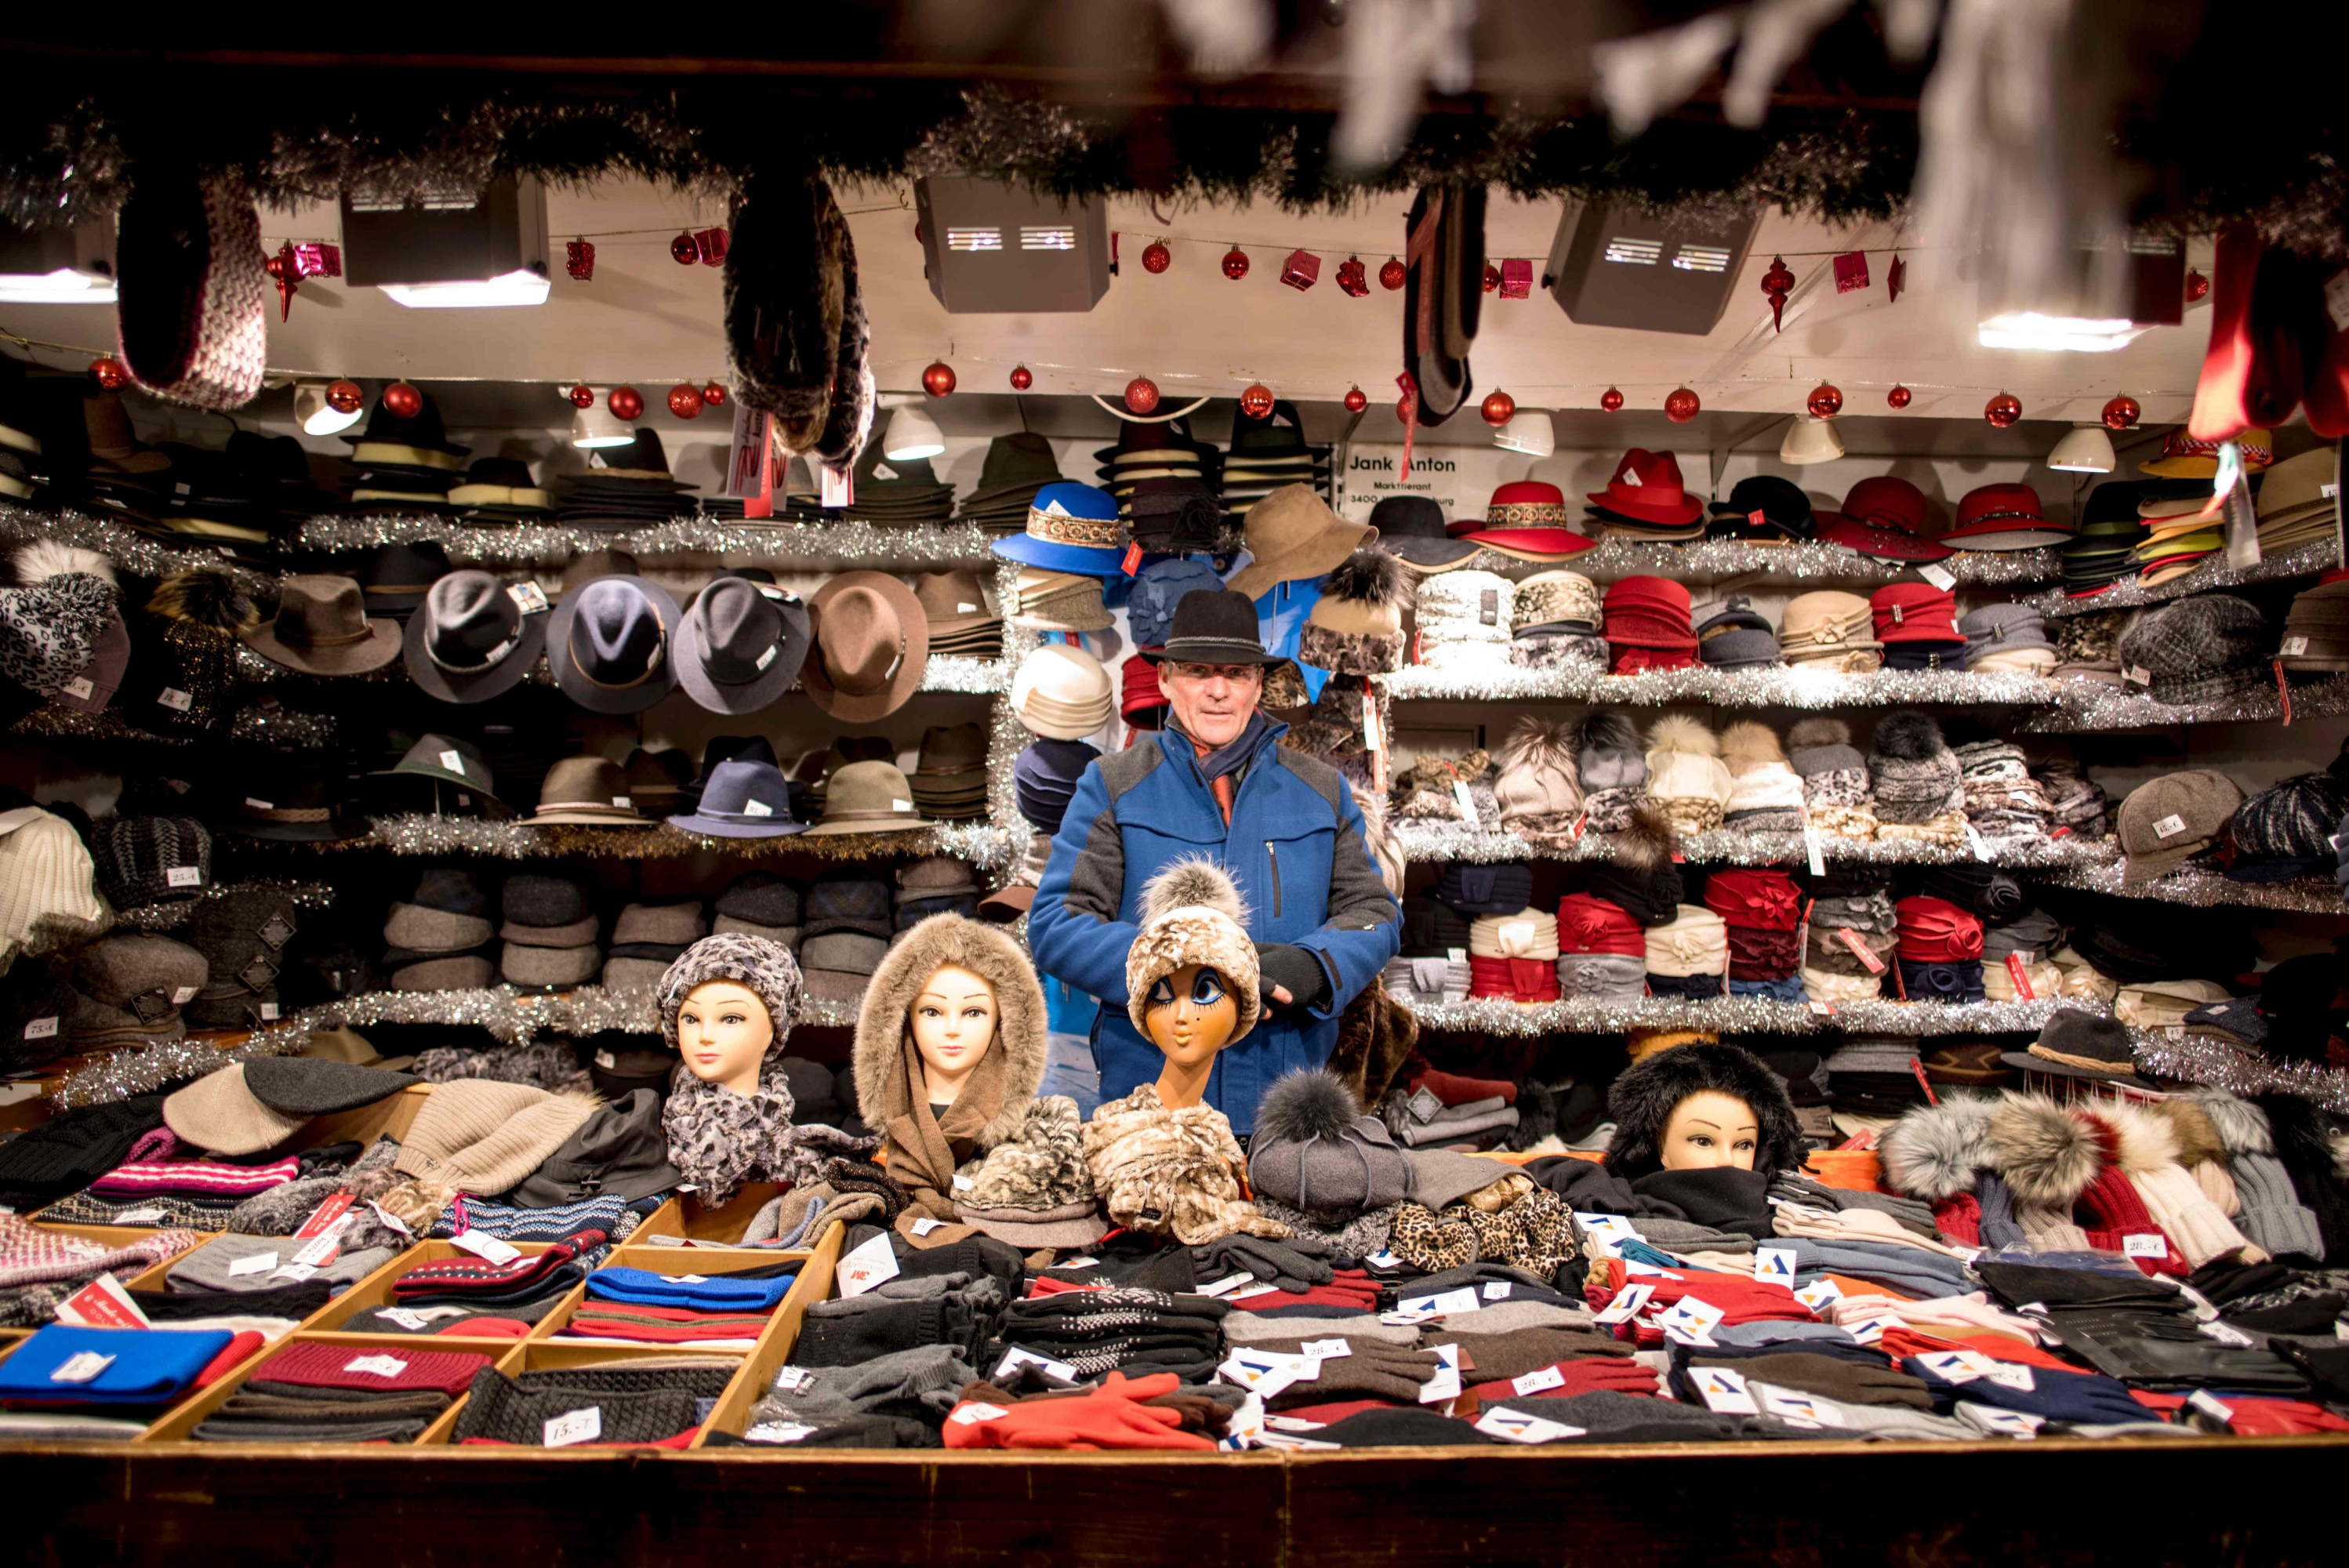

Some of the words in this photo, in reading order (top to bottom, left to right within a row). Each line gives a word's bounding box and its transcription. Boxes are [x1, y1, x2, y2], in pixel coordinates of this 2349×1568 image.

[1349, 456, 1393, 470] Jank
[172, 873, 197, 882] 25.-€
[31, 1022, 54, 1034] 75.-€
[2129, 1241, 2161, 1253] 28.-€
[850, 1269, 870, 1280] 3M
